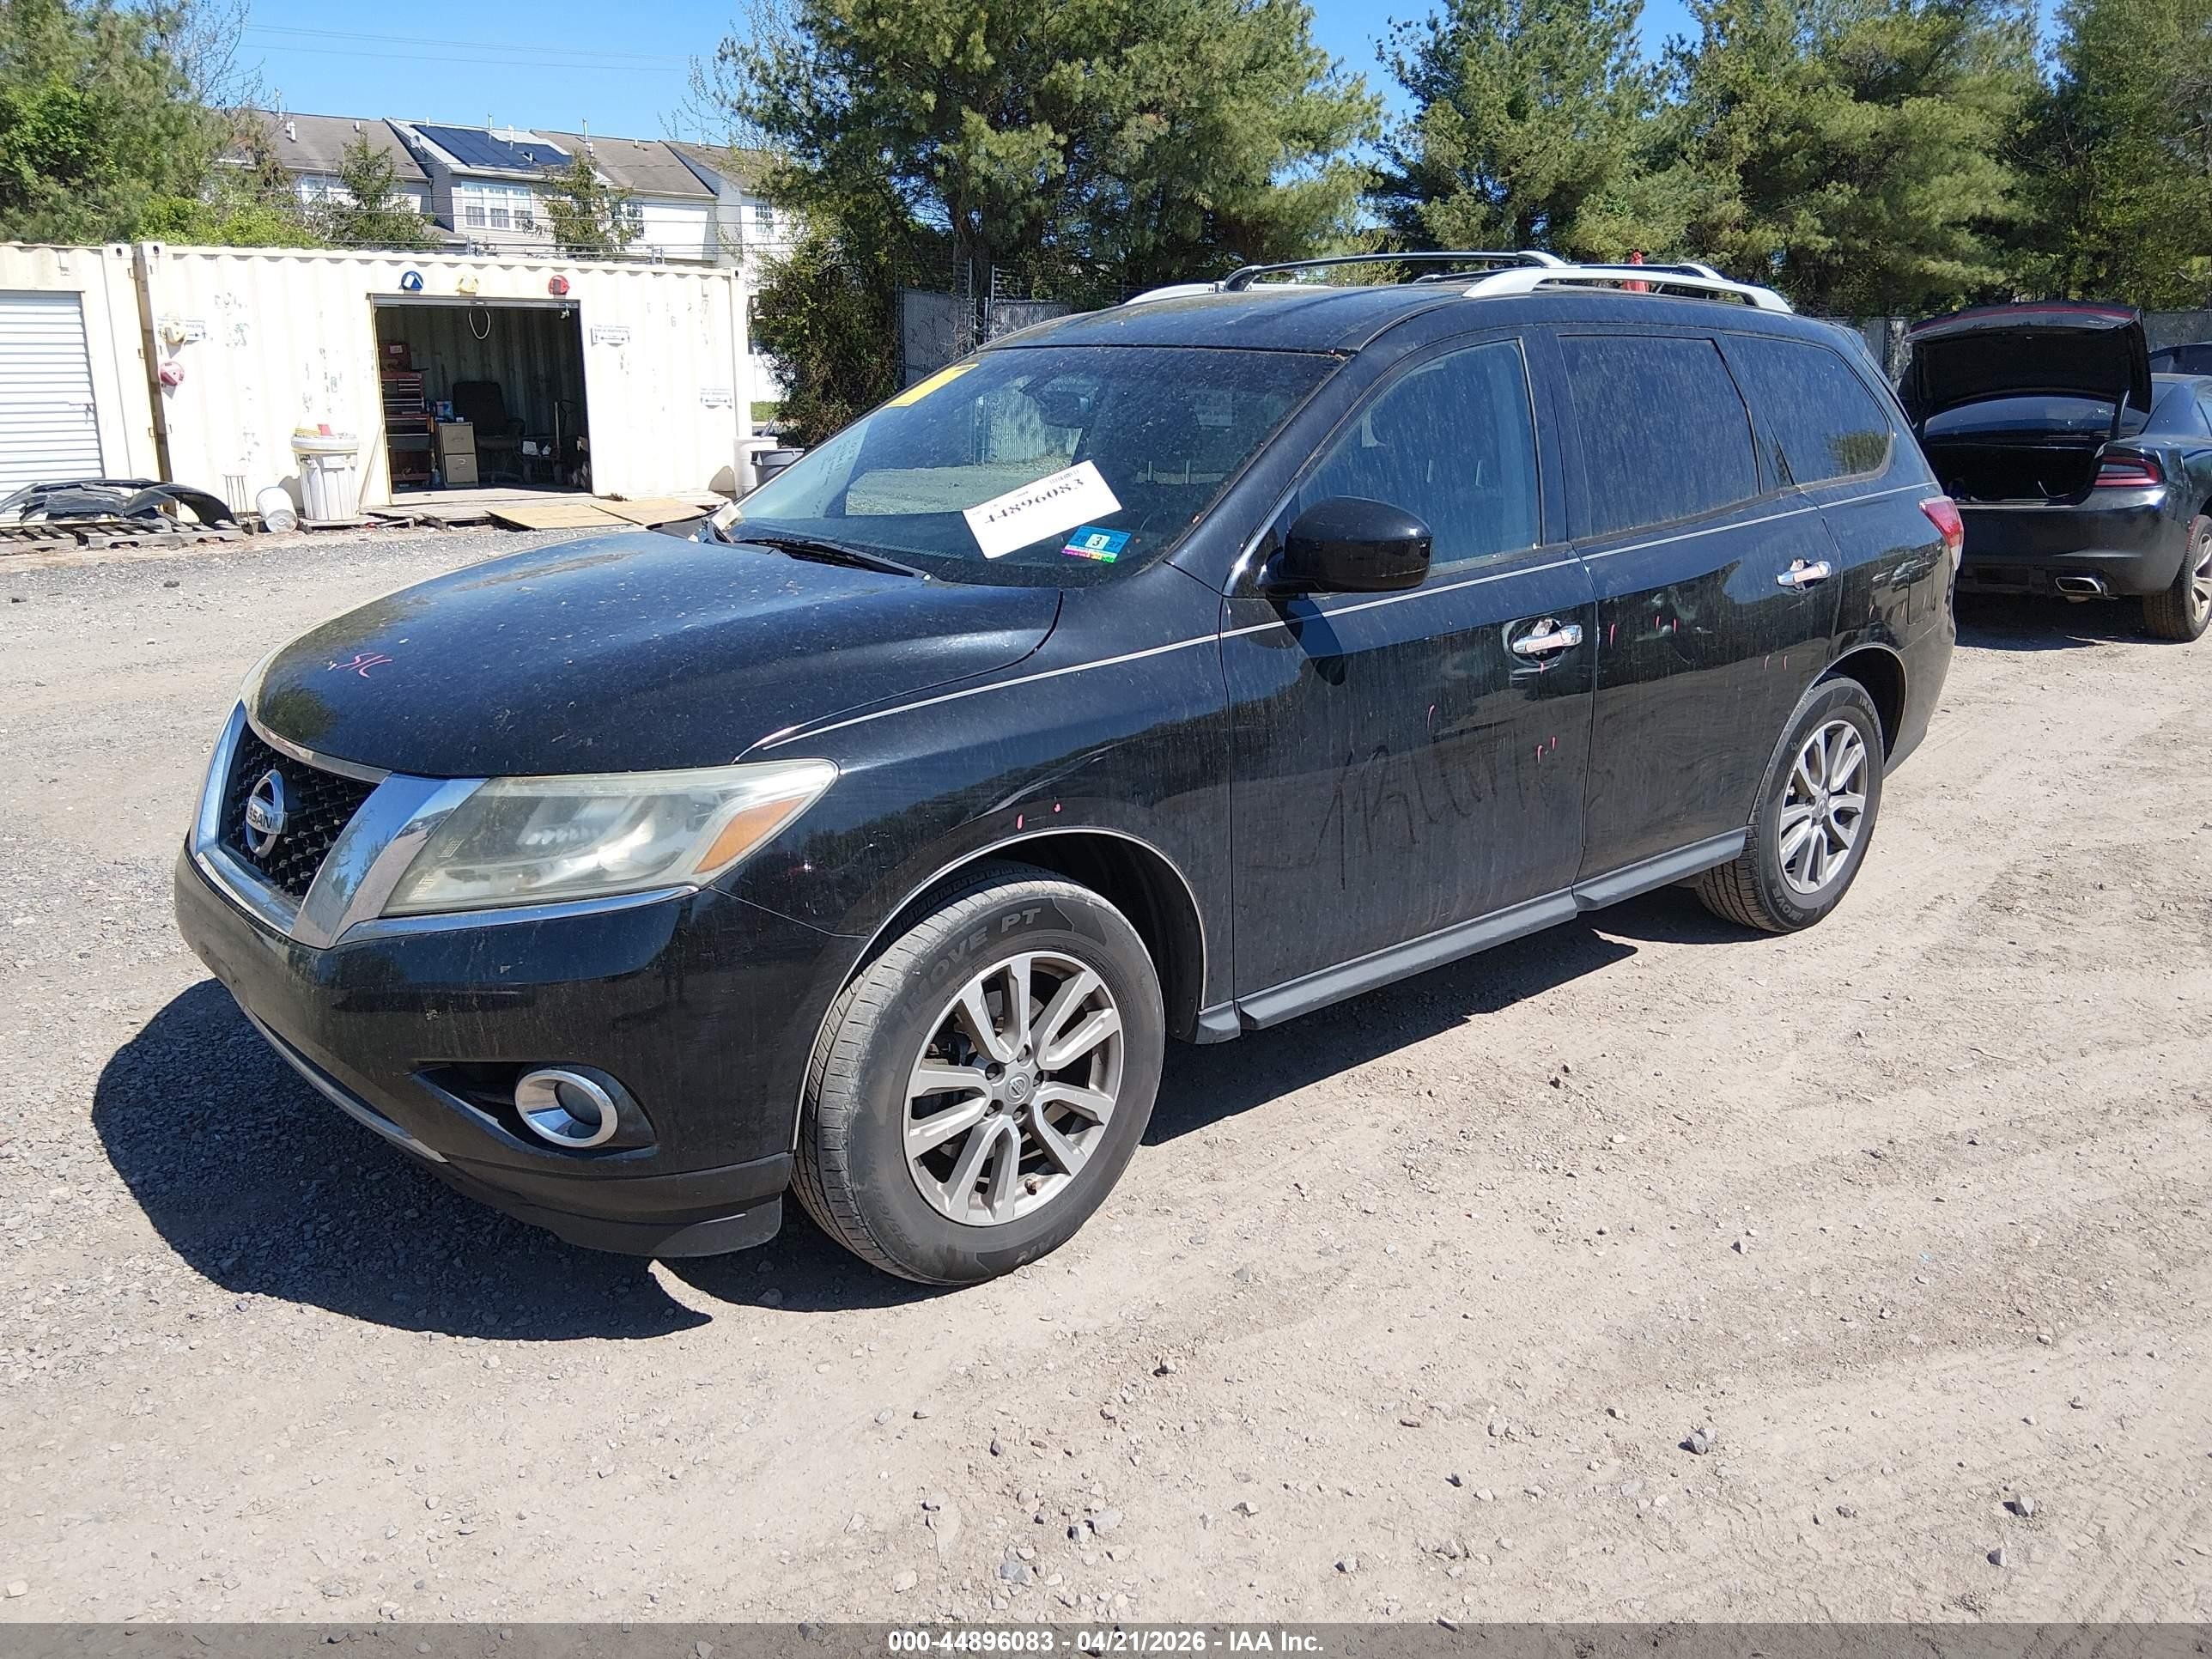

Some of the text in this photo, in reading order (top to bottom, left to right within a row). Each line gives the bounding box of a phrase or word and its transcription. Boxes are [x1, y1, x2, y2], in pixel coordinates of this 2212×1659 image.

[984, 478, 1085, 525] 44896083
[1092, 536, 1103, 547] 3
[247, 805, 273, 829] SSAN
[1000, 908, 1042, 933] PT
